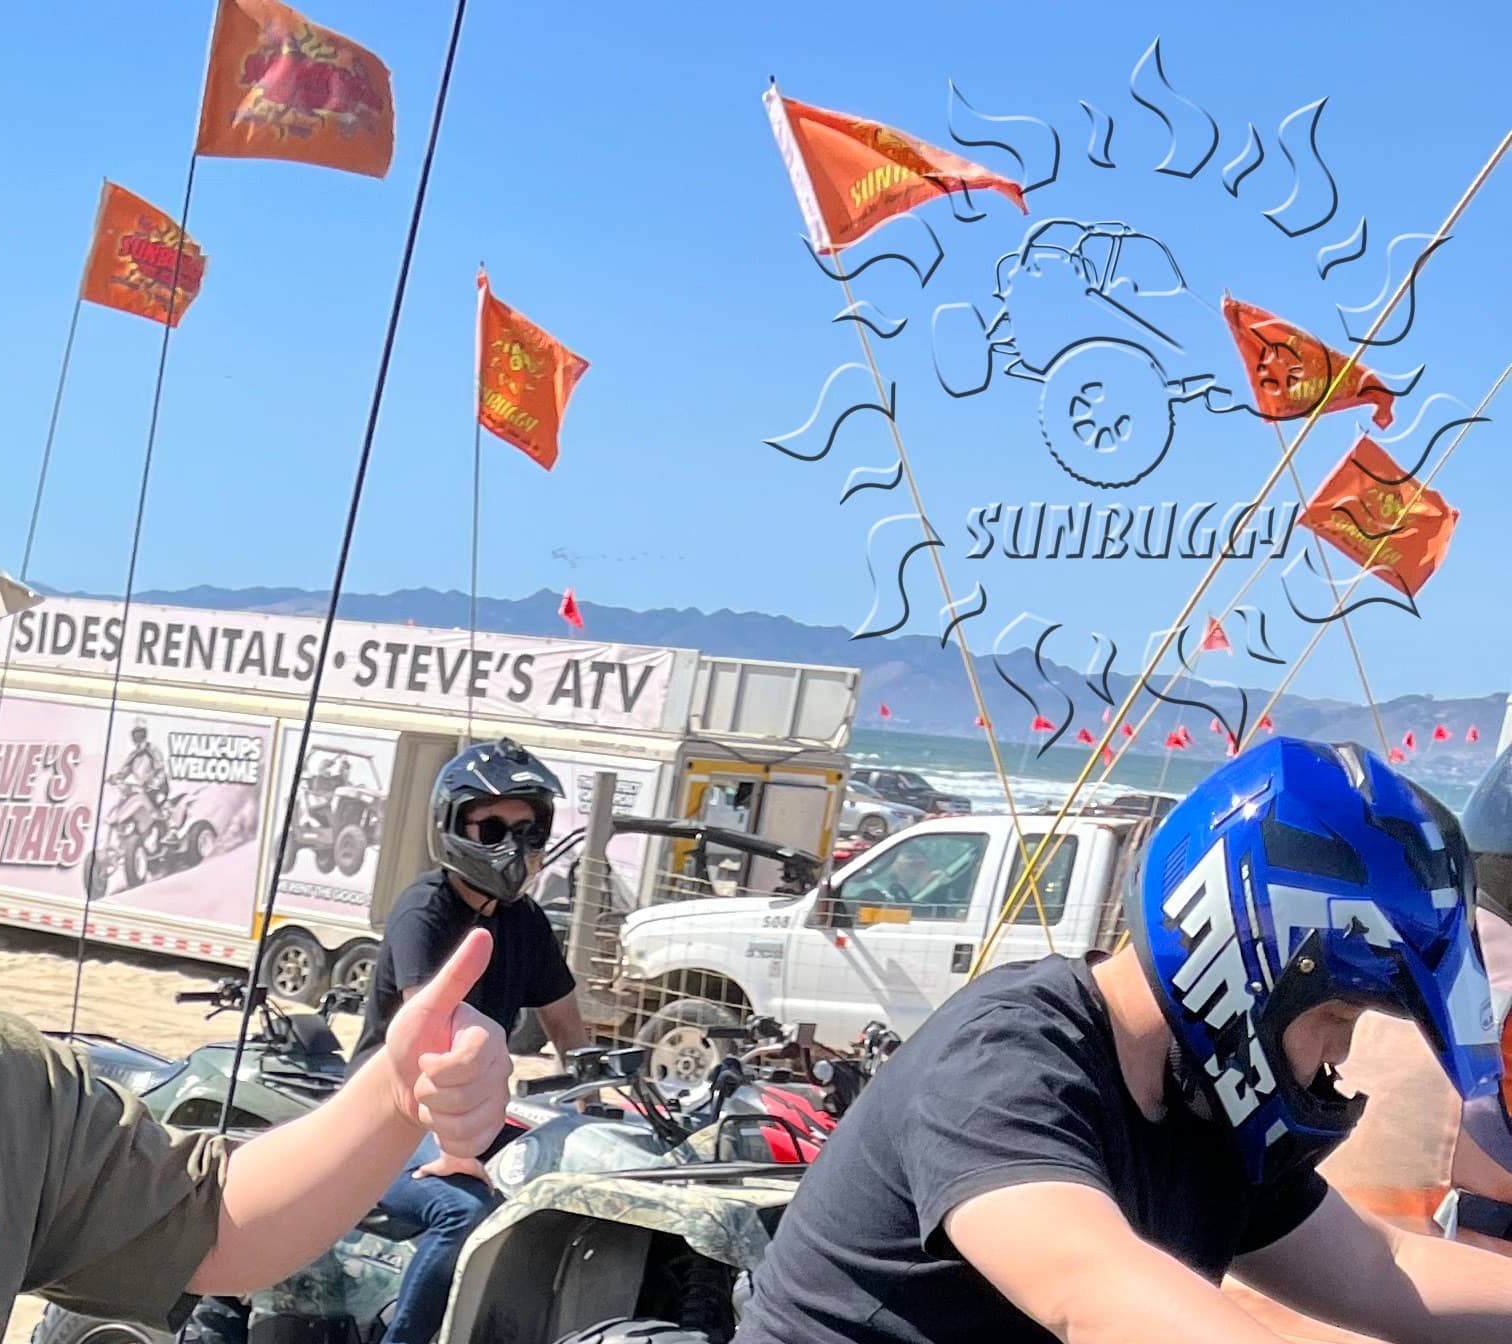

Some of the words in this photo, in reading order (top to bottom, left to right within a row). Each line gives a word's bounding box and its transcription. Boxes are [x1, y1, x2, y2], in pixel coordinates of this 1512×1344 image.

[14, 609, 123, 663] SIDES
[135, 620, 318, 682] RENTALS
[353, 638, 535, 703] STEVE'S
[547, 658, 656, 714] ATV
[168, 731, 262, 760] WALK-UPS
[169, 757, 259, 785] WELCOME
